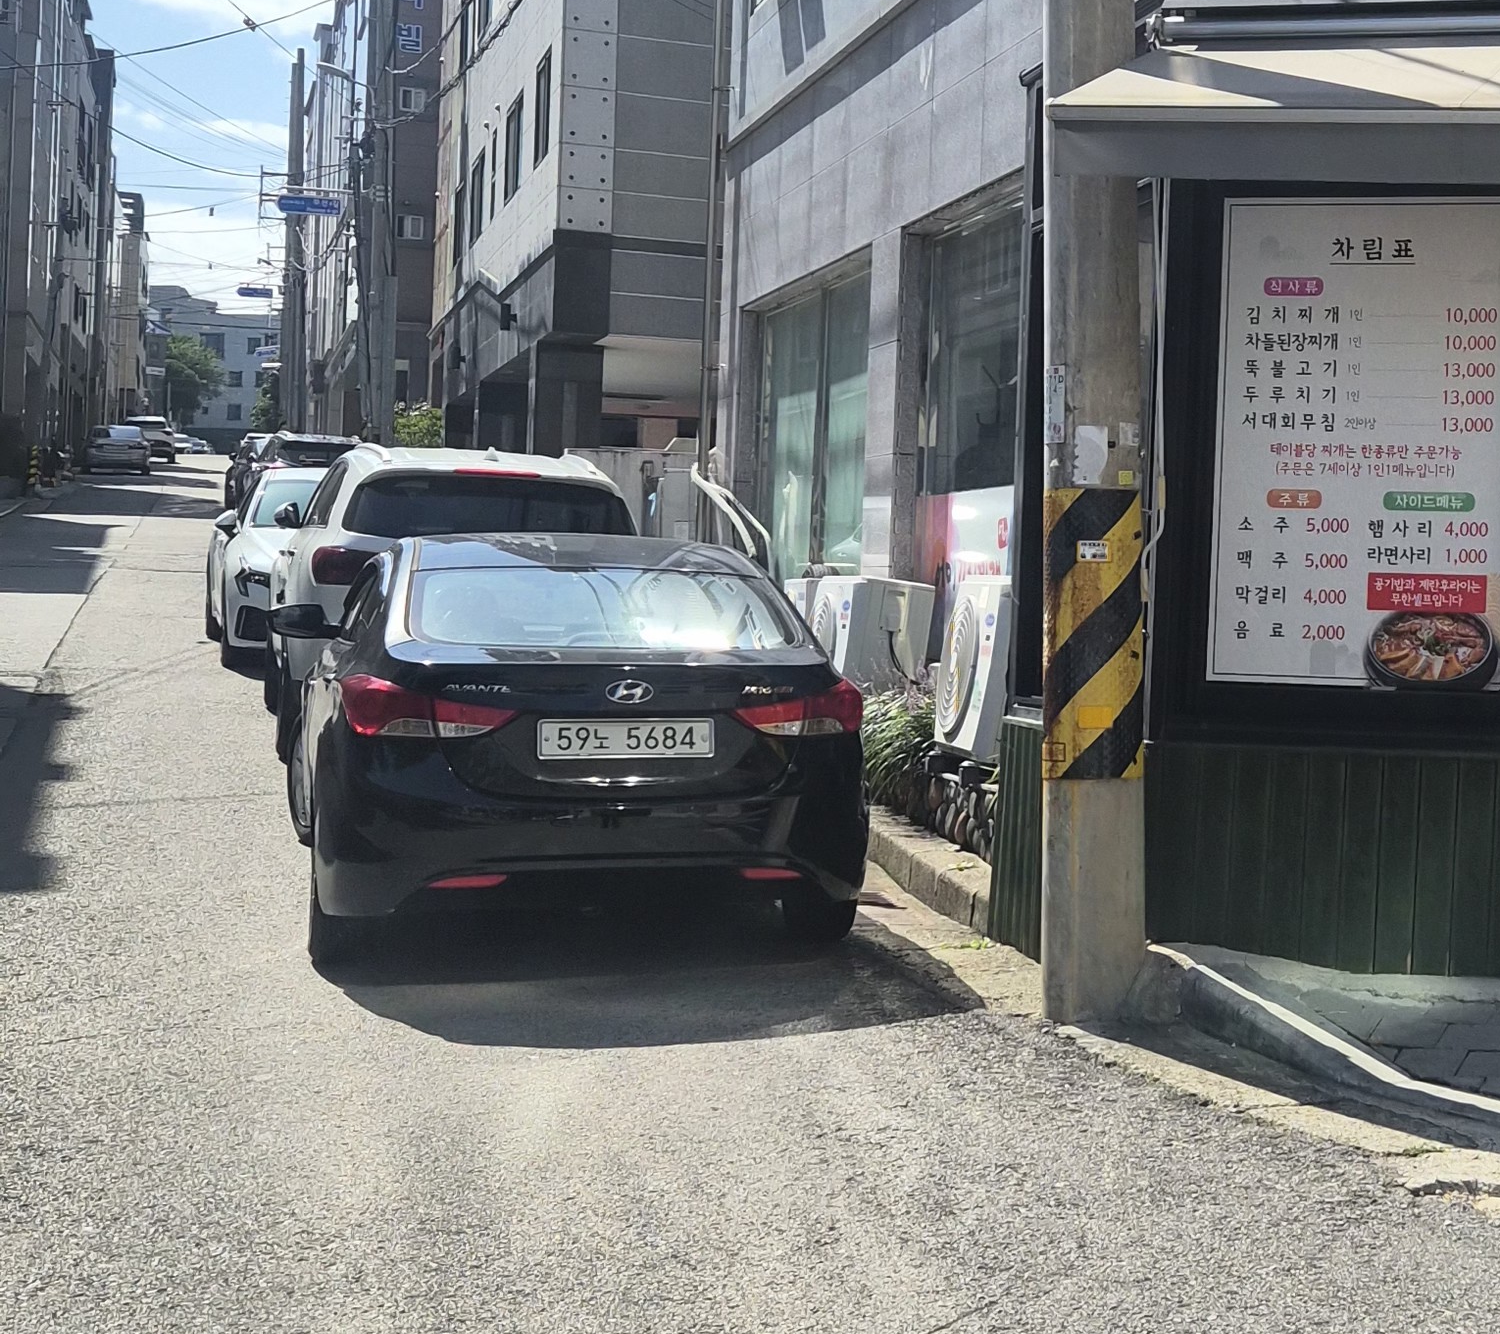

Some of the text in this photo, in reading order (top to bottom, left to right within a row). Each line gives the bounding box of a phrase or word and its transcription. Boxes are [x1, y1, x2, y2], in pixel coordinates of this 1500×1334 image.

[1331, 237, 1415, 260] 차림표
[1269, 279, 1319, 294] 식사류
[1246, 306, 1498, 325] 김치찌개 1인 10,000
[1349, 336, 1362, 348] 1인
[1444, 335, 1497, 352] 10,000
[1244, 360, 1496, 380] 뚝불고기 1인 13,000
[1243, 386, 1495, 407] 두루치기 1인 13,000
[1241, 412, 1494, 434] 서대회무침 2인이상 13,000
[1270, 443, 1463, 461] 테이블당 찌개는 한종류만 주문가능
[1275, 461, 1315, 477] (주문은
[1319, 462, 1362, 478] 7세이상
[1278, 493, 1310, 507] 주류
[1395, 494, 1464, 510] 사이드메뉴
[1238, 516, 1350, 534] 소주 5,000
[1368, 519, 1489, 538] 햄사리 4,000
[1237, 549, 1348, 570] 맥주 5,000
[1367, 546, 1488, 565] 라면사리 1,000
[1373, 577, 1416, 592] 공기밥과
[1235, 585, 1347, 606] 막걸리 4,000
[1390, 592, 1463, 608] 무한셀프입니다
[1234, 620, 1345, 642] 음료 2,000
[441, 683, 512, 694] AVANTE
[556, 726, 697, 751] 59노 5684
